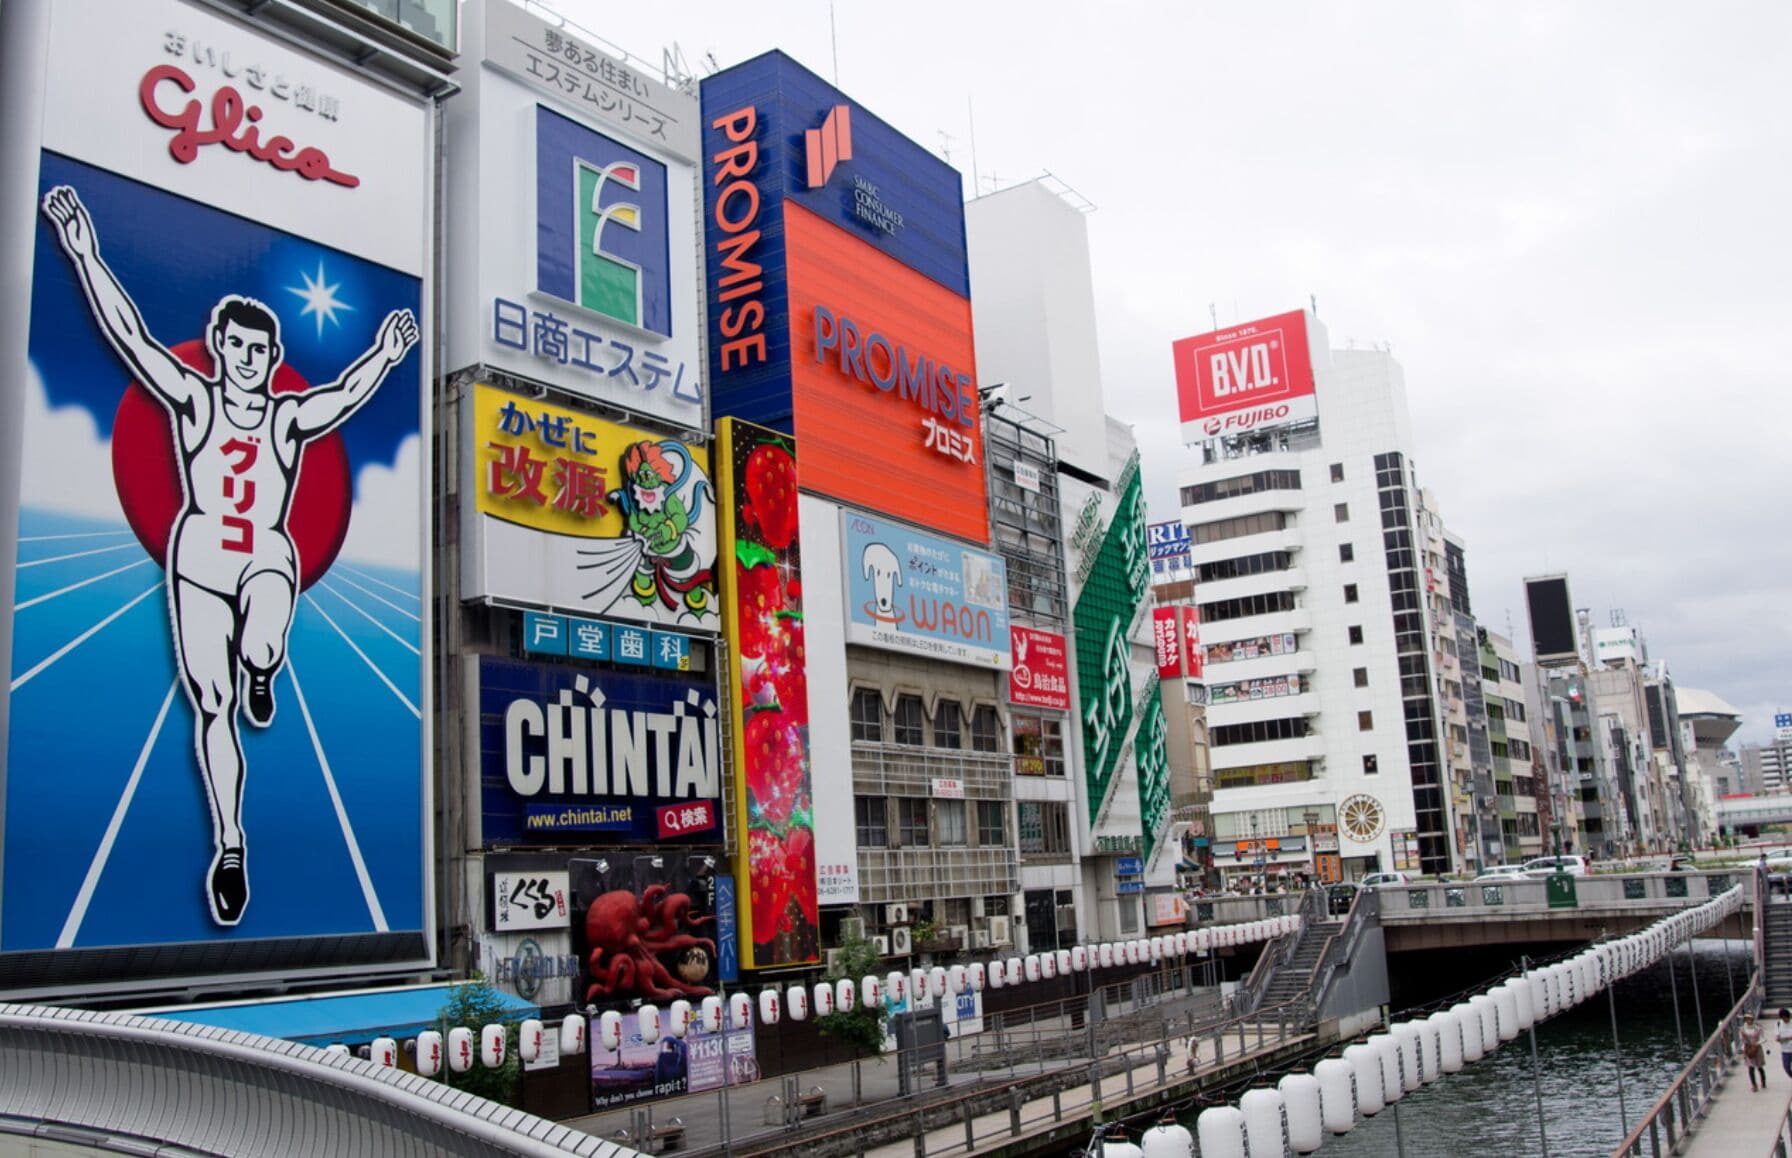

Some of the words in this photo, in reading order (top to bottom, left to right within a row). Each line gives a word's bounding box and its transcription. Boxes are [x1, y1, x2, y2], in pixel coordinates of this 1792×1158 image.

[543, 28, 649, 98] 夢ある住まい
[526, 53, 666, 141] エステムシリーズ
[139, 64, 361, 191] Glico
[854, 174, 880, 200] SMBC
[854, 188, 905, 229] CONSUMER
[712, 105, 767, 372] PROMISE
[856, 204, 896, 236] FINANCE
[494, 296, 704, 406] 日商エステム
[814, 304, 974, 428] PROMISE
[1209, 342, 1279, 398] B.V.D.
[498, 401, 598, 456] かぜに
[921, 417, 977, 465] プロミス
[1225, 404, 1290, 430] FUJIBO
[219, 436, 262, 555] グリコ
[486, 441, 609, 518] 改源
[533, 617, 683, 662] 戸堂歯科
[910, 592, 992, 643] WAON
[1164, 617, 1179, 666] カラオケ
[505, 674, 720, 799] CHINTAI
[680, 805, 709, 829] 検索
[510, 878, 556, 920] くくる
